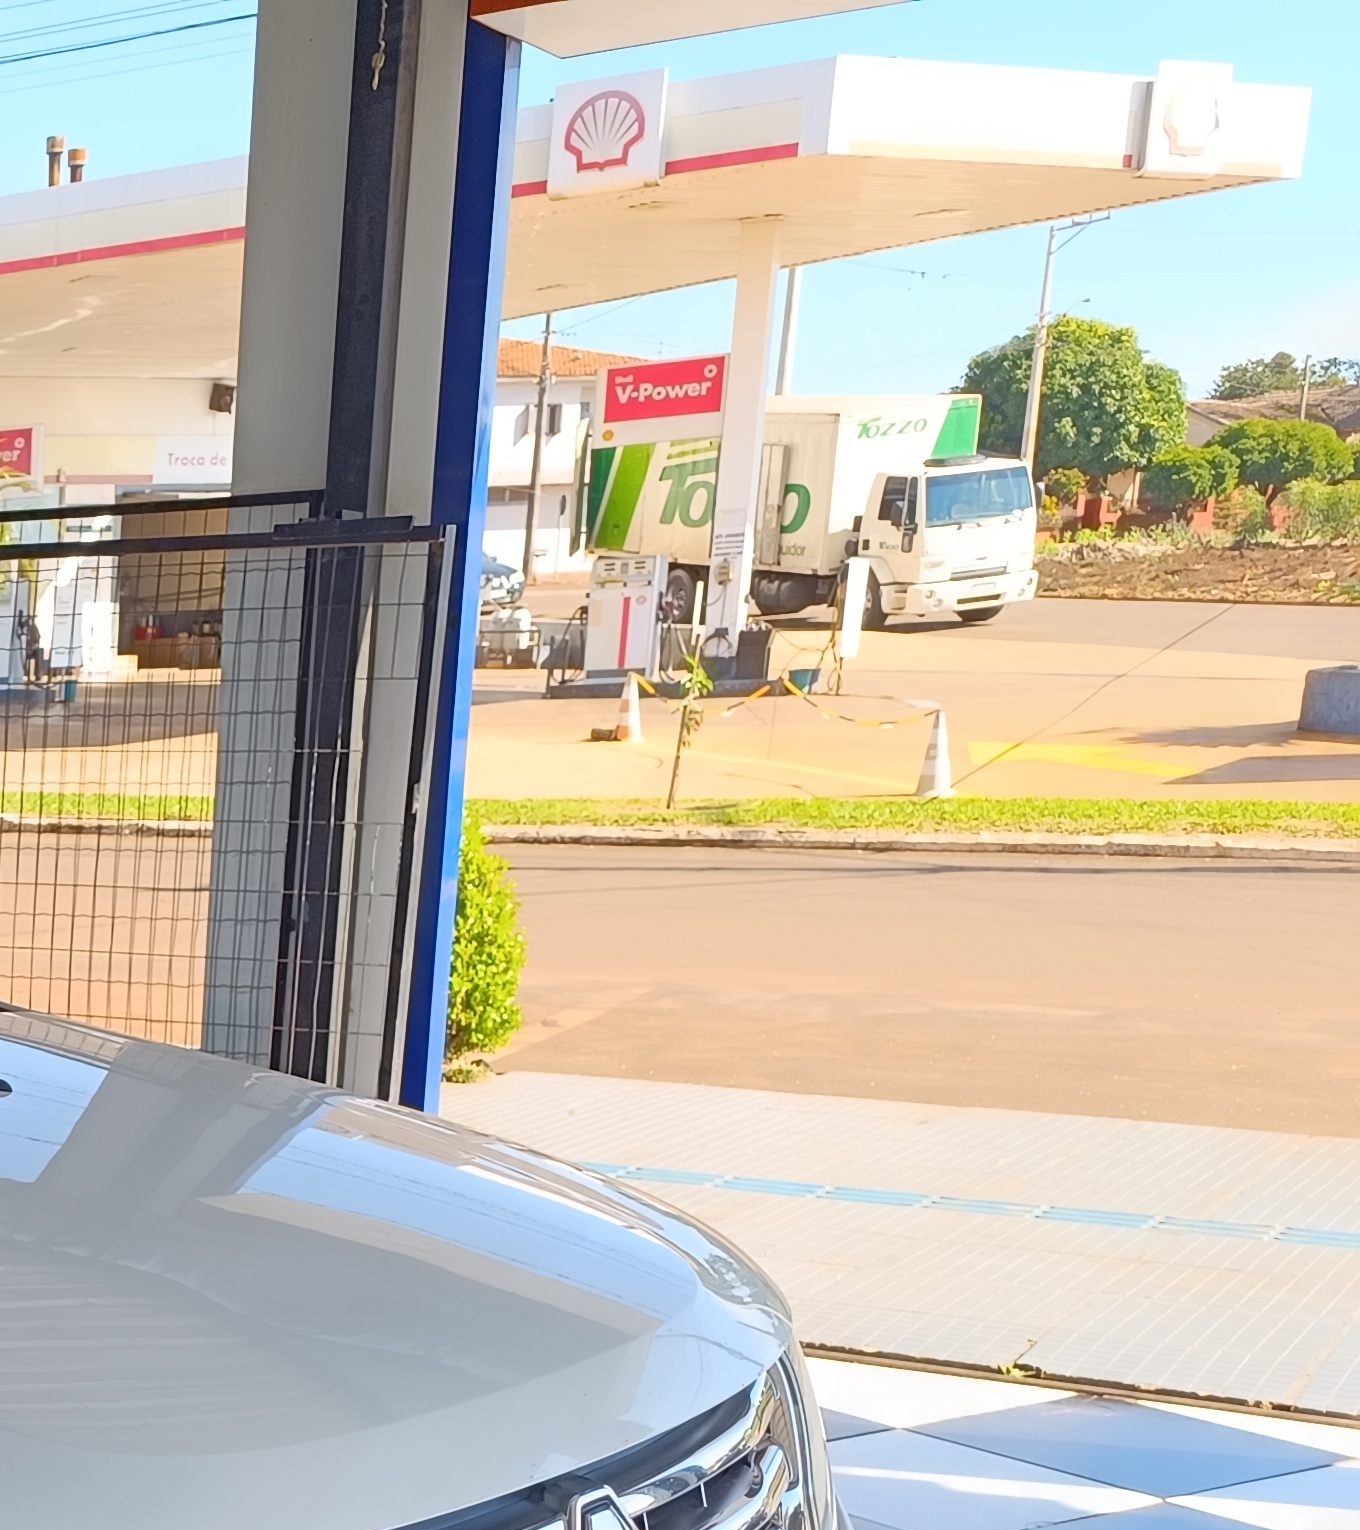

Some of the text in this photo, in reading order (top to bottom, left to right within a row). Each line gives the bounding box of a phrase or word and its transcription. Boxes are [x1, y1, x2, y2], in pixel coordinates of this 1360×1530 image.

[614, 380, 713, 405] V-Power
[167, 451, 228, 467] Troca de
